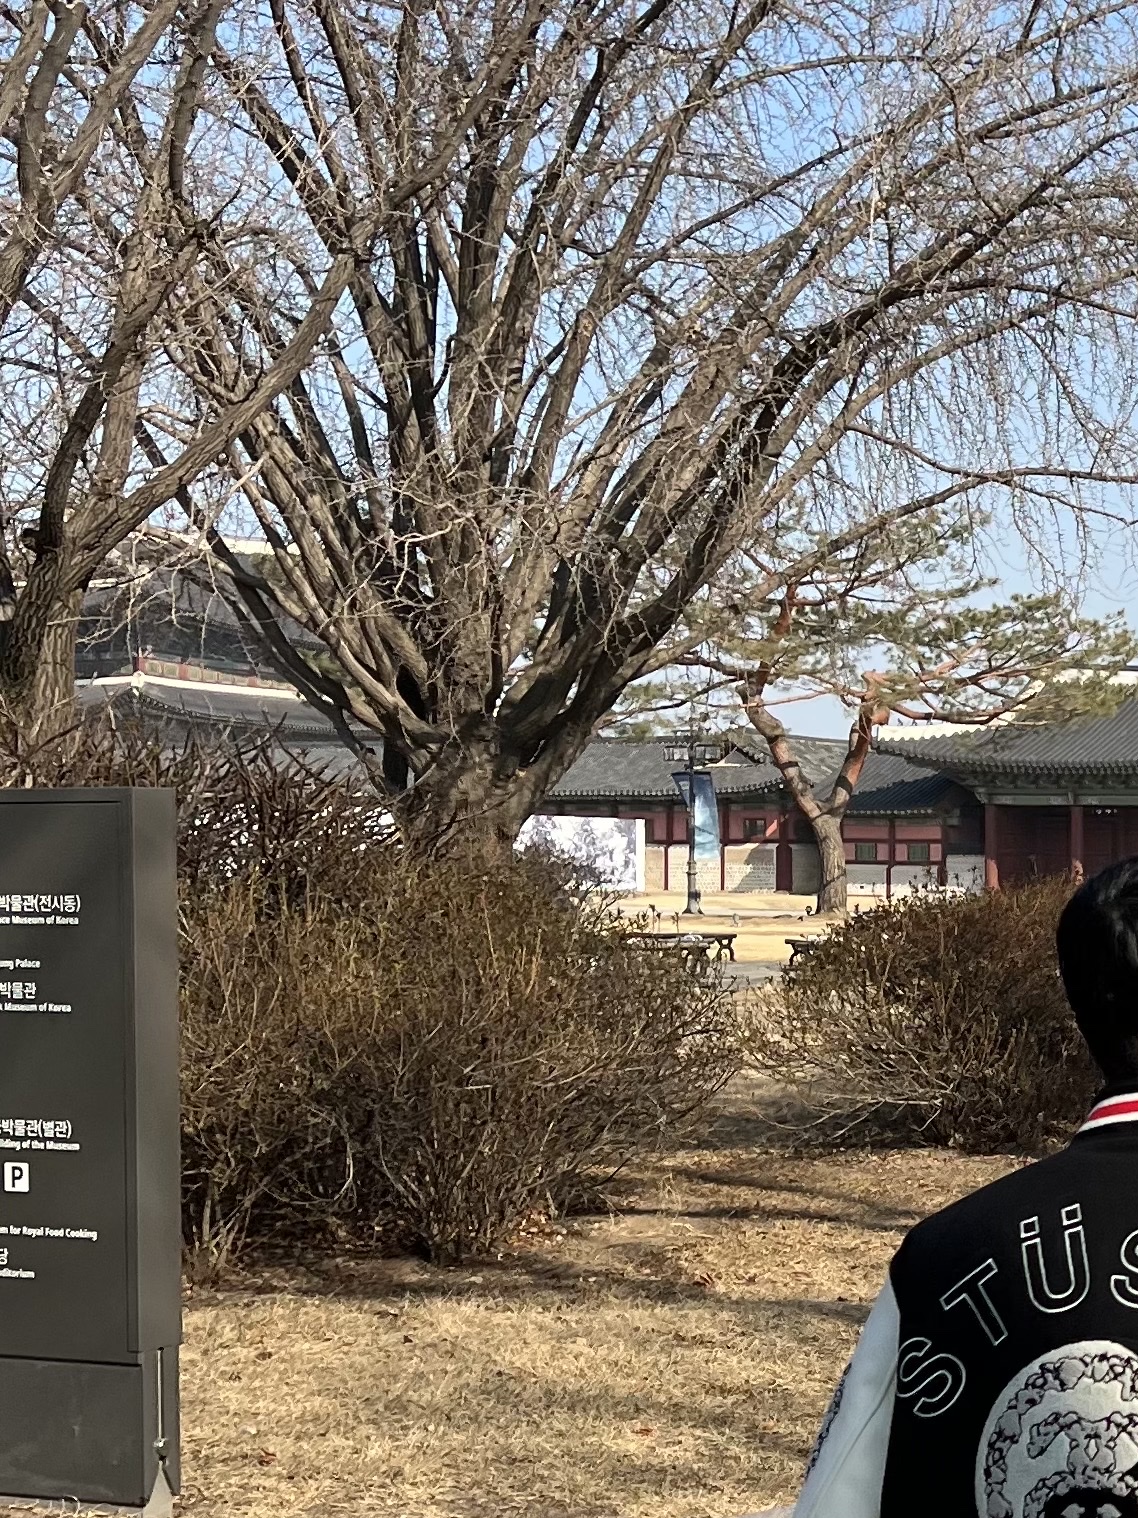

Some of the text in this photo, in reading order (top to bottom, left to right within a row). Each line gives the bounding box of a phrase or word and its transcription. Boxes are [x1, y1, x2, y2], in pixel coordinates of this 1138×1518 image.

[11, 915, 45, 925] Museum
[45, 915, 55, 925] of
[55, 916, 79, 925] Korea
[15, 958, 41, 968] Palace
[0, 981, 37, 999] 박물관
[4, 1002, 38, 1012] Museum
[38, 1002, 48, 1012] of
[48, 1003, 72, 1013] Korea
[0, 1118, 72, 1139] 박물관(별관)
[21, 1139, 31, 1149] of
[31, 1140, 45, 1150] the
[45, 1140, 81, 1151] Museum
[9, 1225, 21, 1235] for
[22, 1226, 44, 1238] Royal
[44, 1227, 65, 1237] Food
[65, 1228, 98, 1241] Cooking
